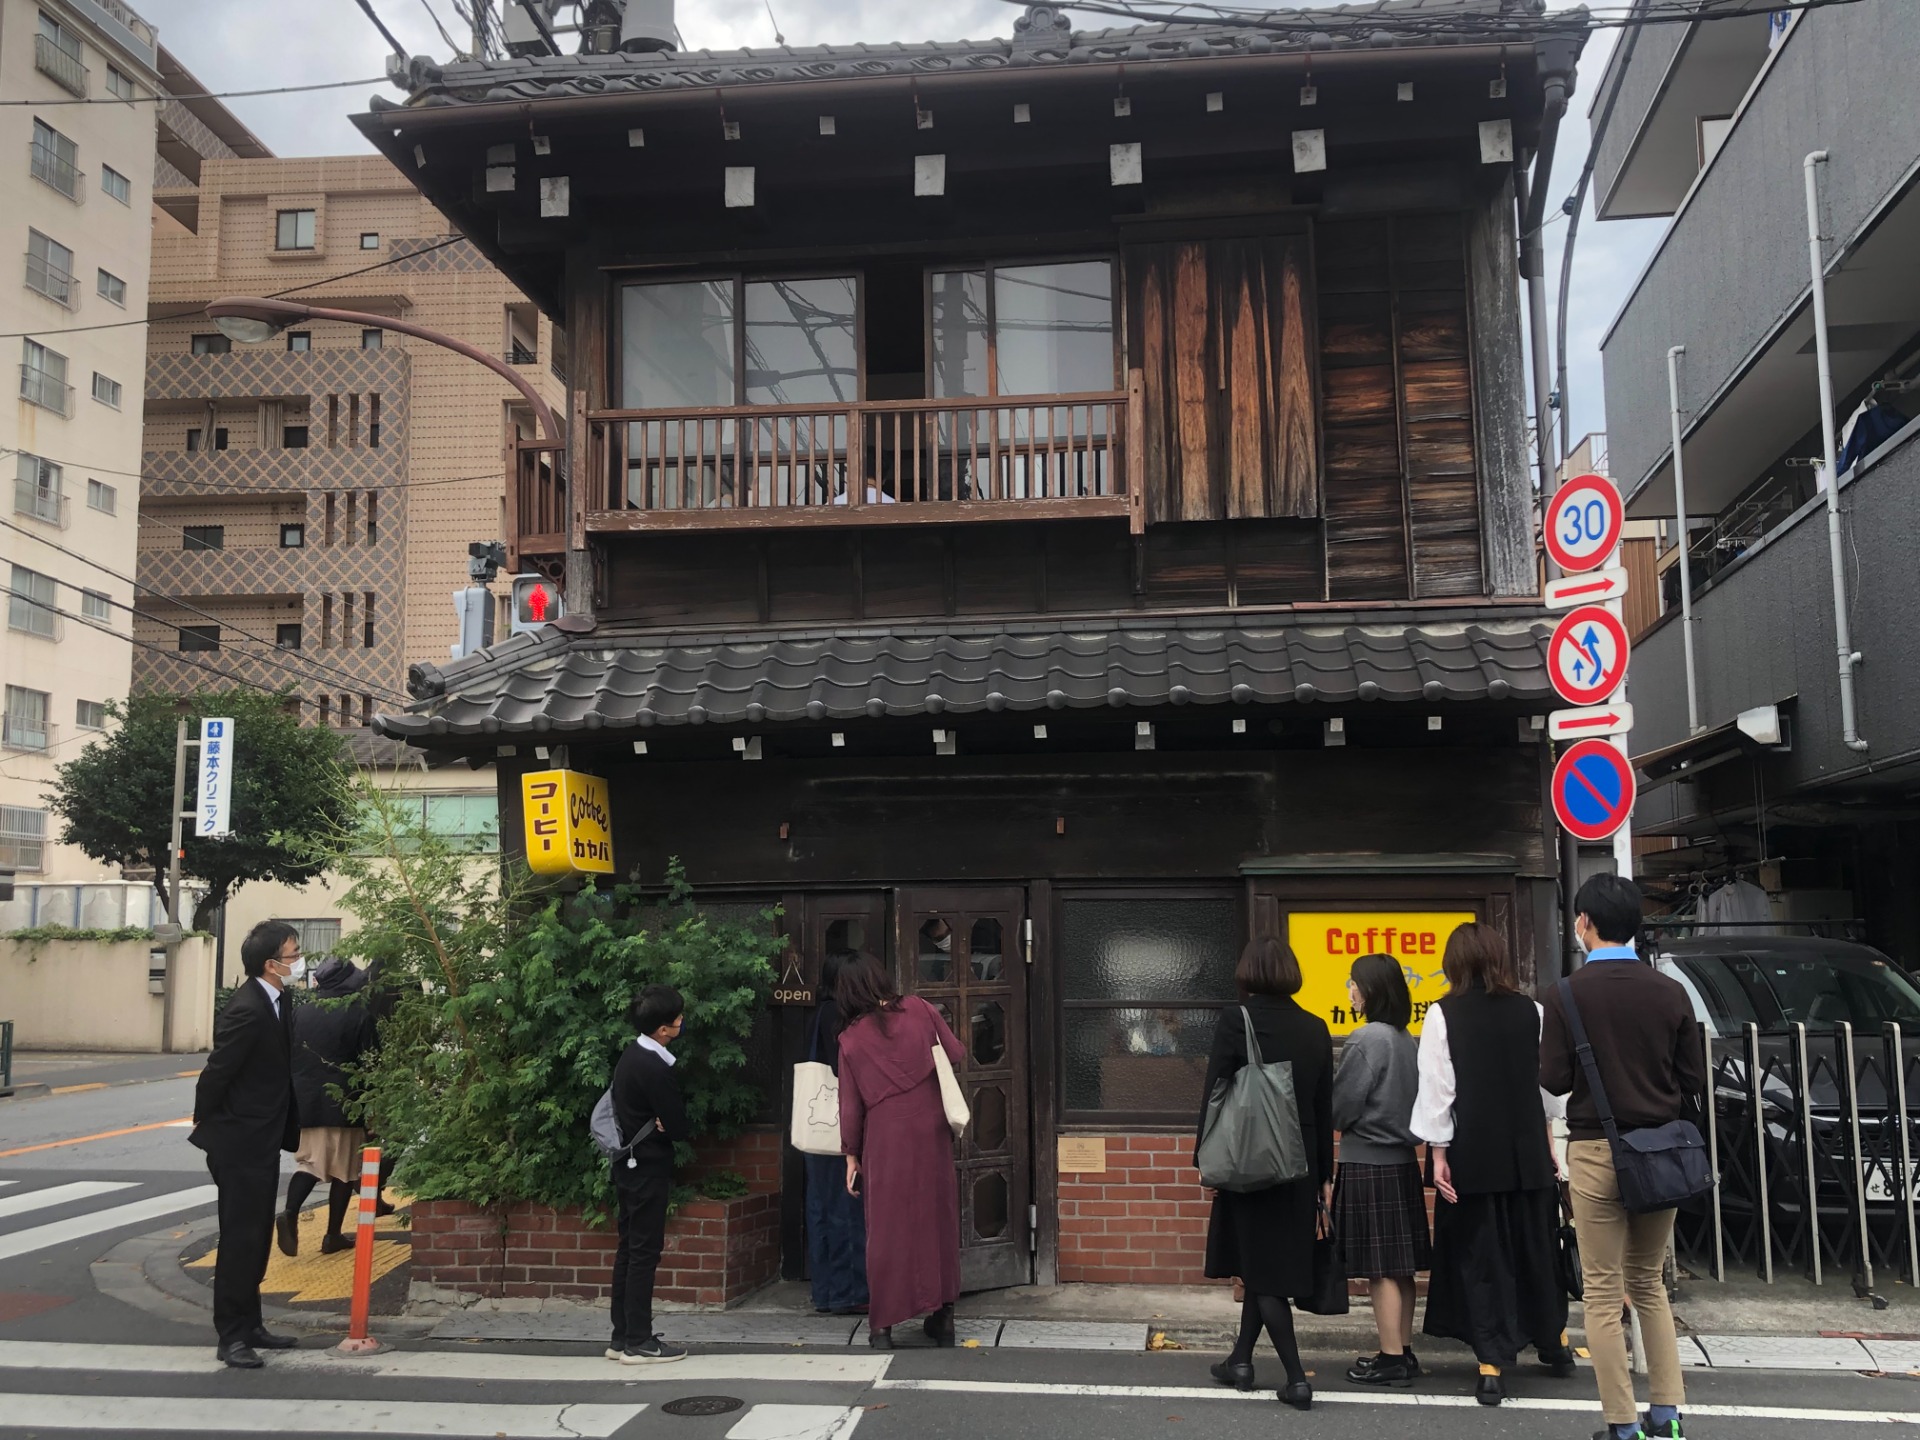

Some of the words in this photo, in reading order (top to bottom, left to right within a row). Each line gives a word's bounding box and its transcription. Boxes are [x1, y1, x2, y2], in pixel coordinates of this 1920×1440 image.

[1563, 499, 1606, 546] 30
[204, 741, 221, 832] 藤本クリニック
[531, 782, 558, 851] コーヒー
[573, 837, 609, 862] カヤバ
[1326, 927, 1436, 955] Coffee
[774, 989, 811, 1003] open
